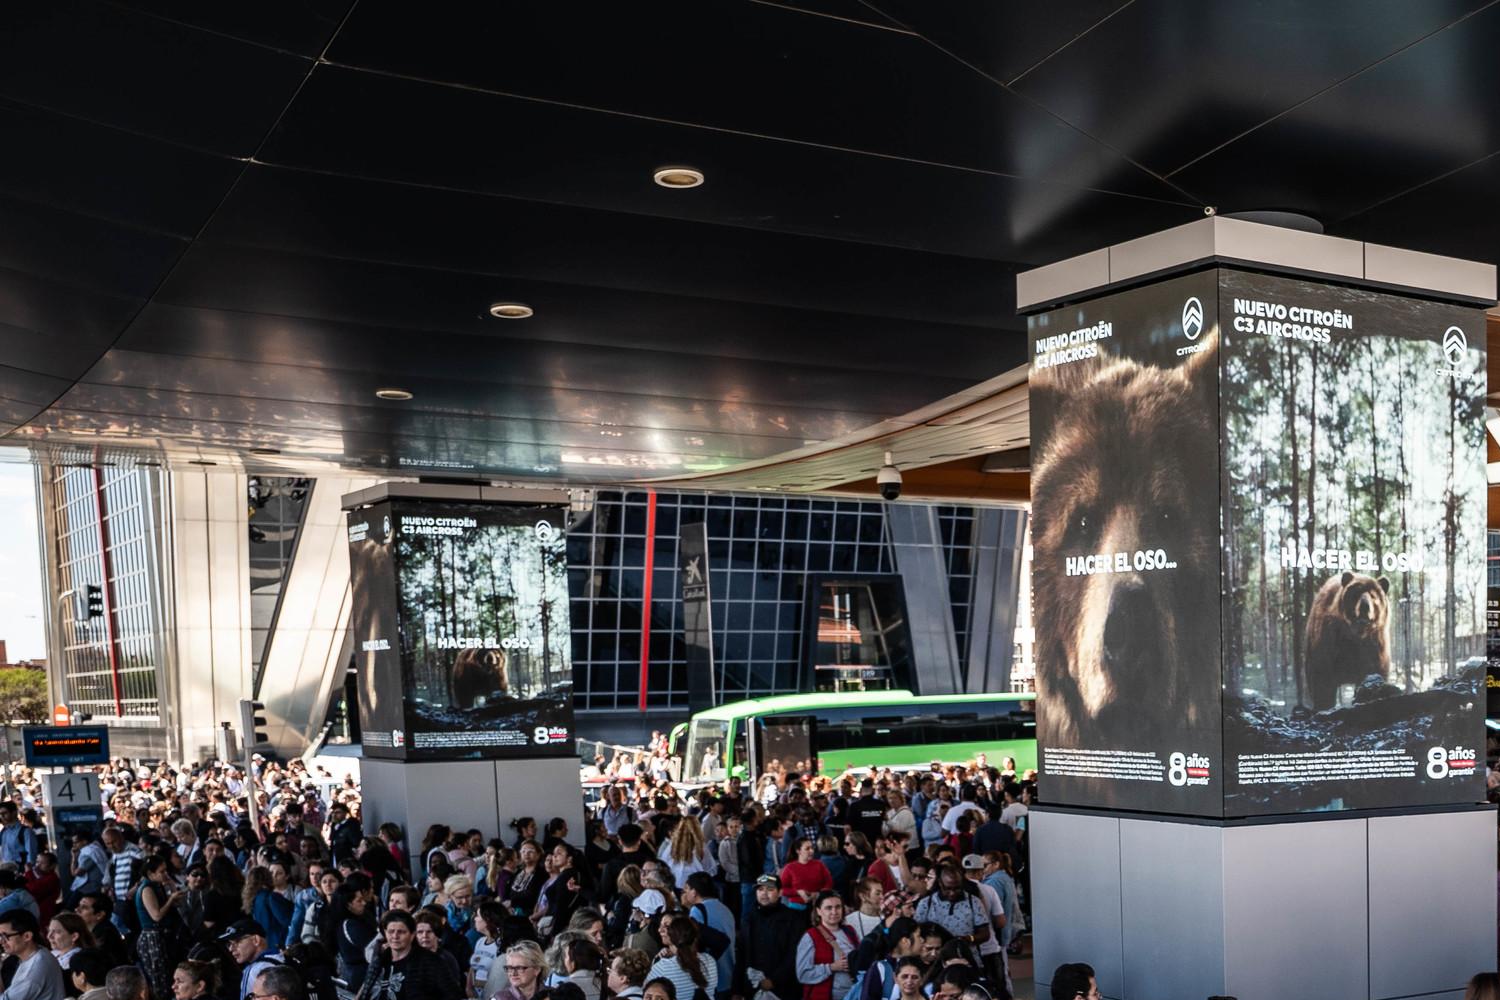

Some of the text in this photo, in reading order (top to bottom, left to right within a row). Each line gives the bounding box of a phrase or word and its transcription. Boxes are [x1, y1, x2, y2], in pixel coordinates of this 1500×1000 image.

[1234, 298, 1353, 330] NUEVO CITROËN
[1036, 320, 1113, 353] NUEVO CITROËN
[1234, 316, 1332, 344] C3 AIRCROSS
[1050, 343, 1098, 366] AIRCROSS
[401, 516, 477, 528] NUEVO CITROËN
[401, 526, 464, 536] C3 AIRCROSS
[1065, 549, 1178, 577] HACER EL OSO...
[1281, 547, 1352, 570] HACER
[1355, 550, 1379, 571] EL
[437, 637, 483, 649] HACER
[484, 637, 500, 649] EL
[534, 726, 550, 745] 8
[1168, 751, 1188, 787] 8
[1186, 752, 1210, 769] años
[1427, 746, 1449, 780] 8
[1448, 745, 1476, 761] años
[57, 777, 93, 803] 41
